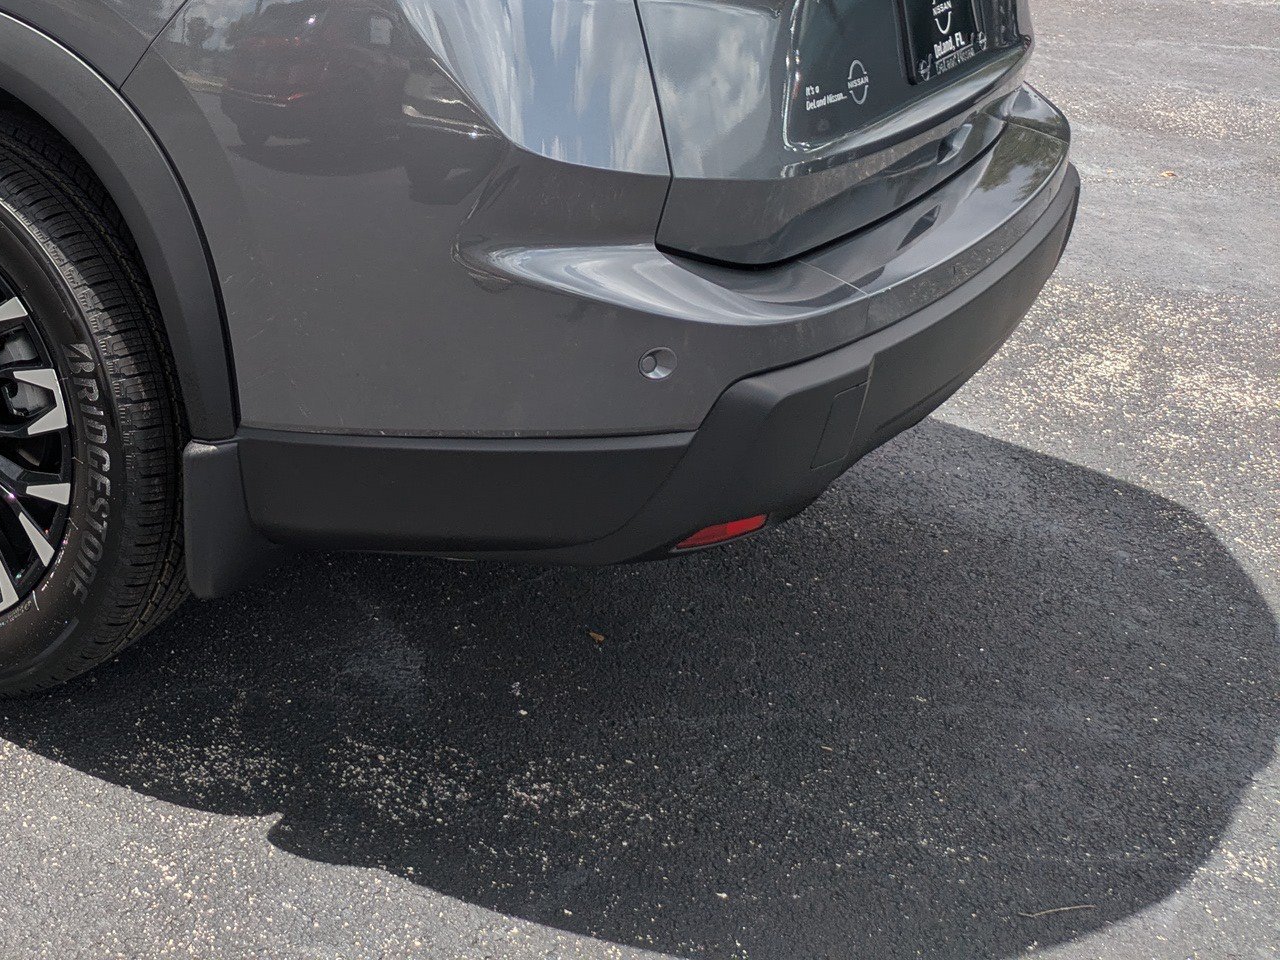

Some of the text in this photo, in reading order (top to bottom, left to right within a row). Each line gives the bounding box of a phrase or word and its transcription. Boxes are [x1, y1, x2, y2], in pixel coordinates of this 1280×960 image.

[932, 0, 952, 16] NISSAN
[954, 32, 966, 47] FL
[847, 75, 869, 89] NISSAN
[805, 96, 826, 111] DeLand
[61, 343, 111, 605] BRIDGESTONE
